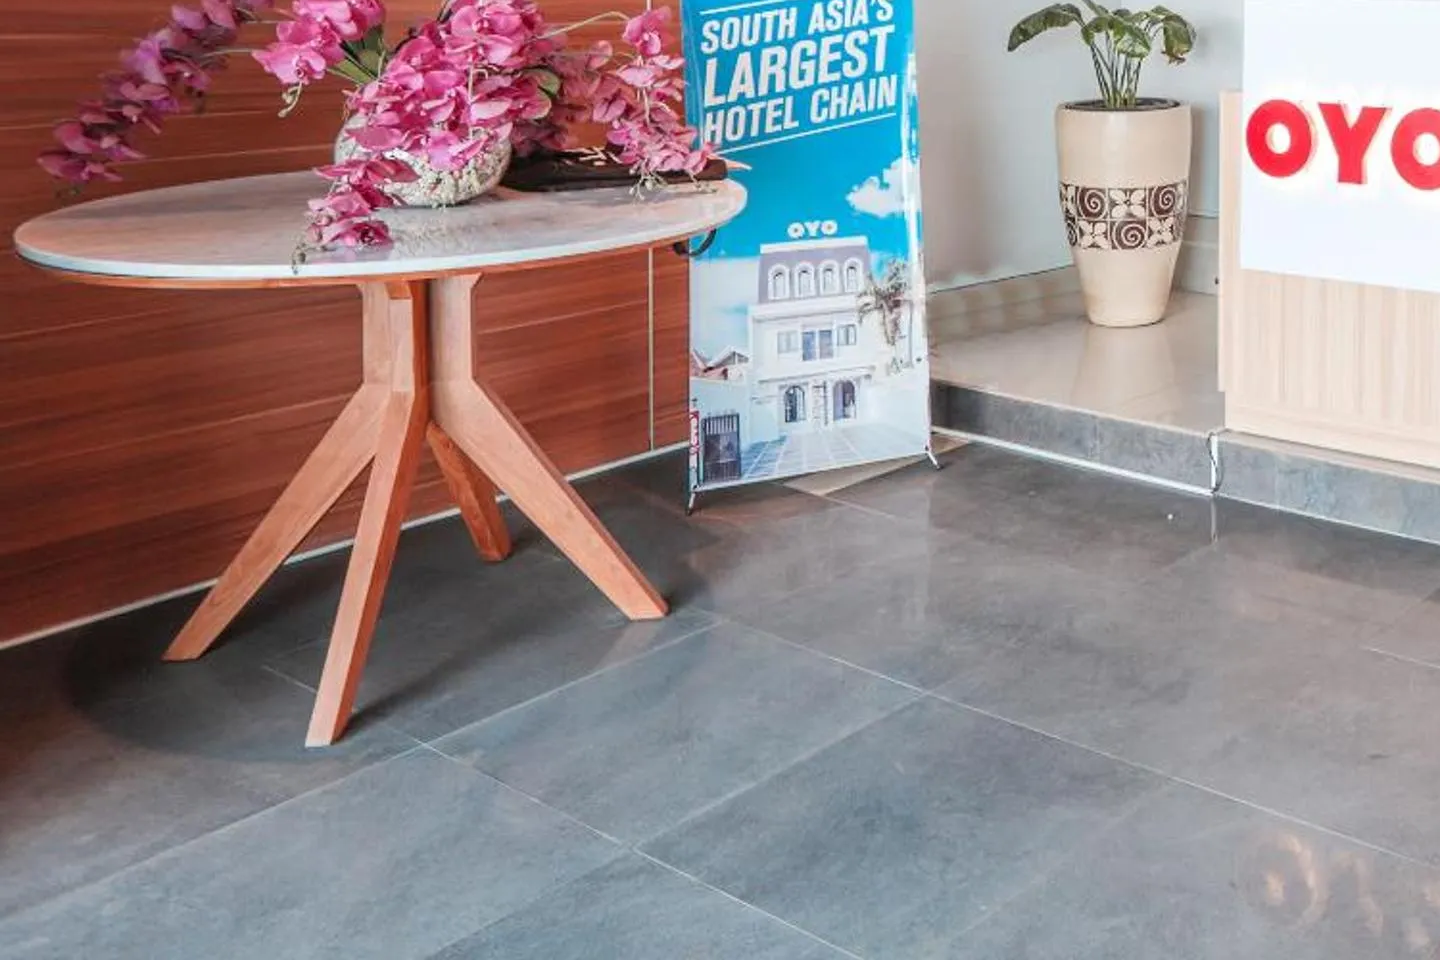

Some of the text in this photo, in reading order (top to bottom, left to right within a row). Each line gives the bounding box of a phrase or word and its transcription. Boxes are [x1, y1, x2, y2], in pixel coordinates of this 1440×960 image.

[701, 6, 798, 54] SOUTH
[703, 24, 896, 108] LARGEST
[703, 74, 898, 144] HOTEL CHAIN
[787, 219, 839, 239] OYO
